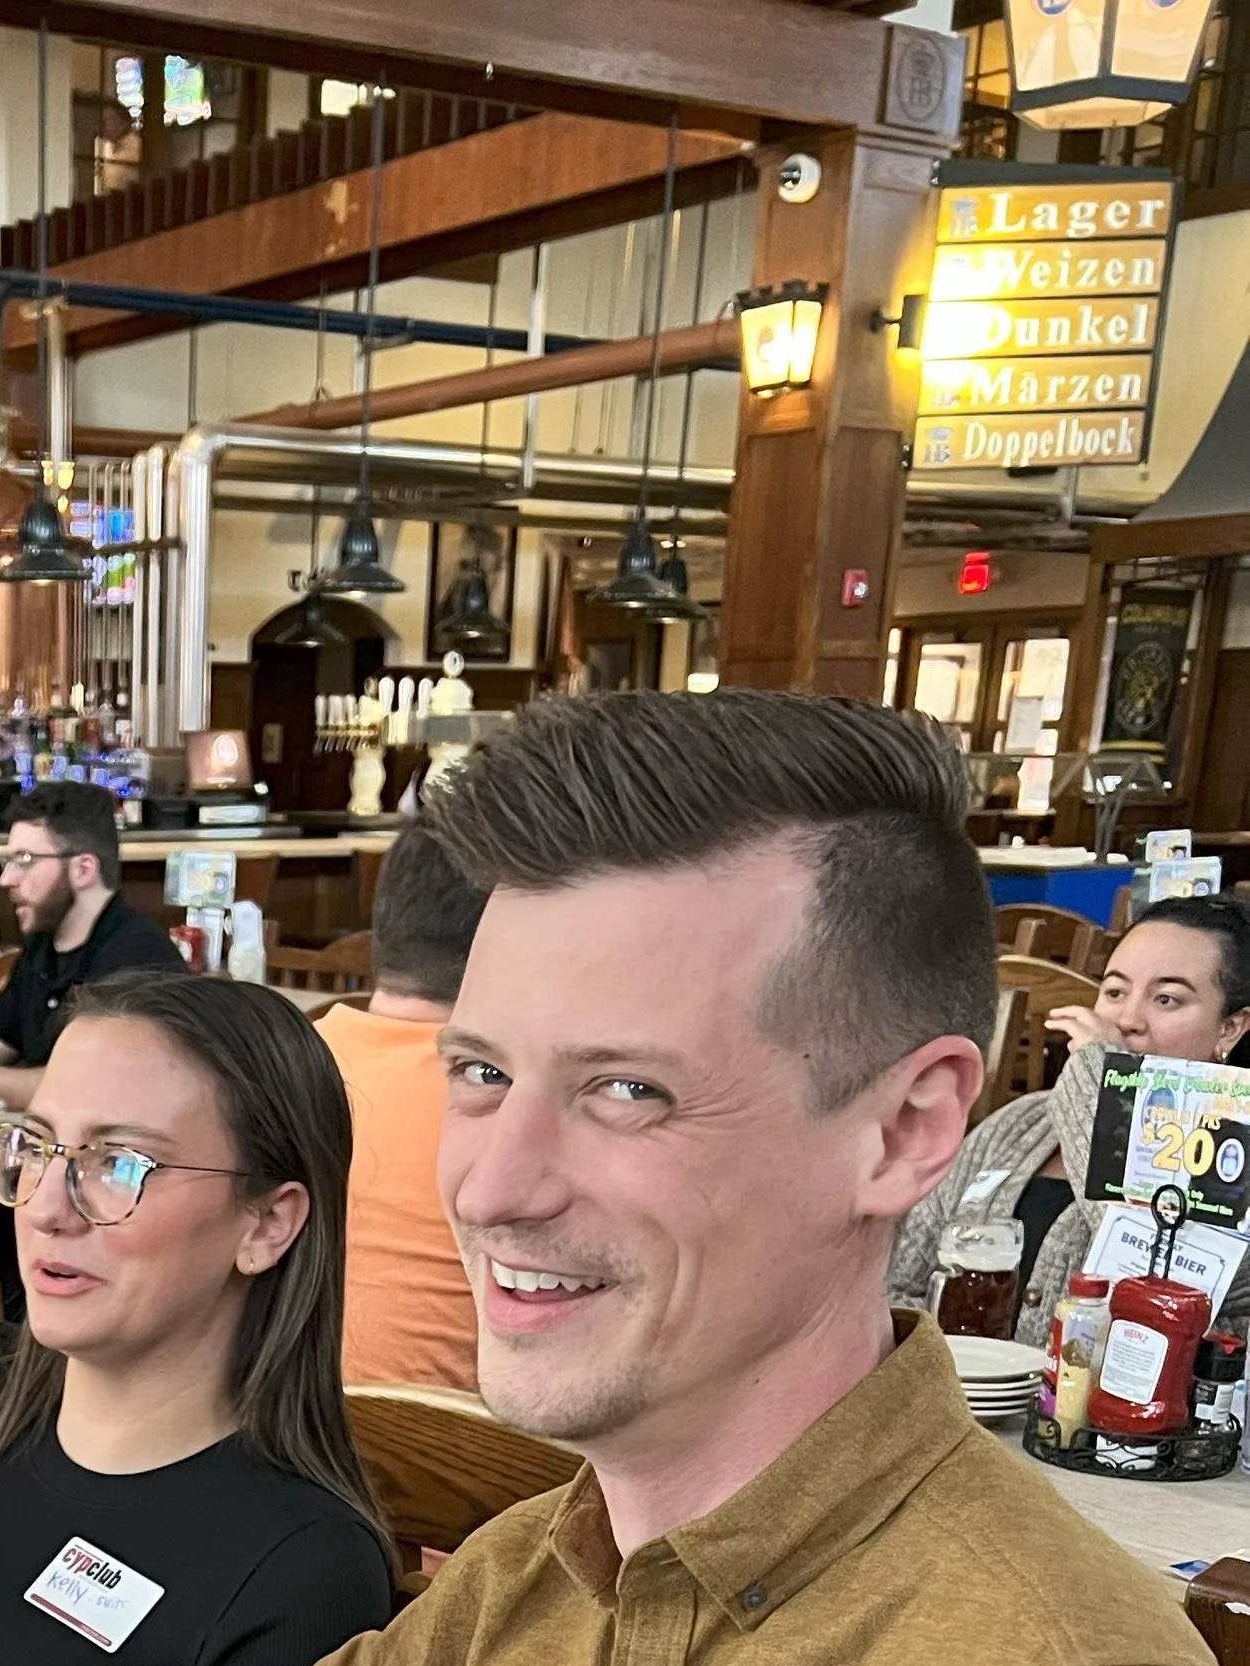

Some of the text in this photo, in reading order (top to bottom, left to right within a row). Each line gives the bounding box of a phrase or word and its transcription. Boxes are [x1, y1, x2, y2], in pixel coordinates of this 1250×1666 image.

[987, 191, 1166, 239] Lager
[969, 364, 1142, 406] Märzen
[962, 416, 1136, 468] Doppelbock
[1142, 1123, 1216, 1177] $20
[1174, 1255, 1208, 1277] BIER
[61, 1546, 123, 1591] cypclub
